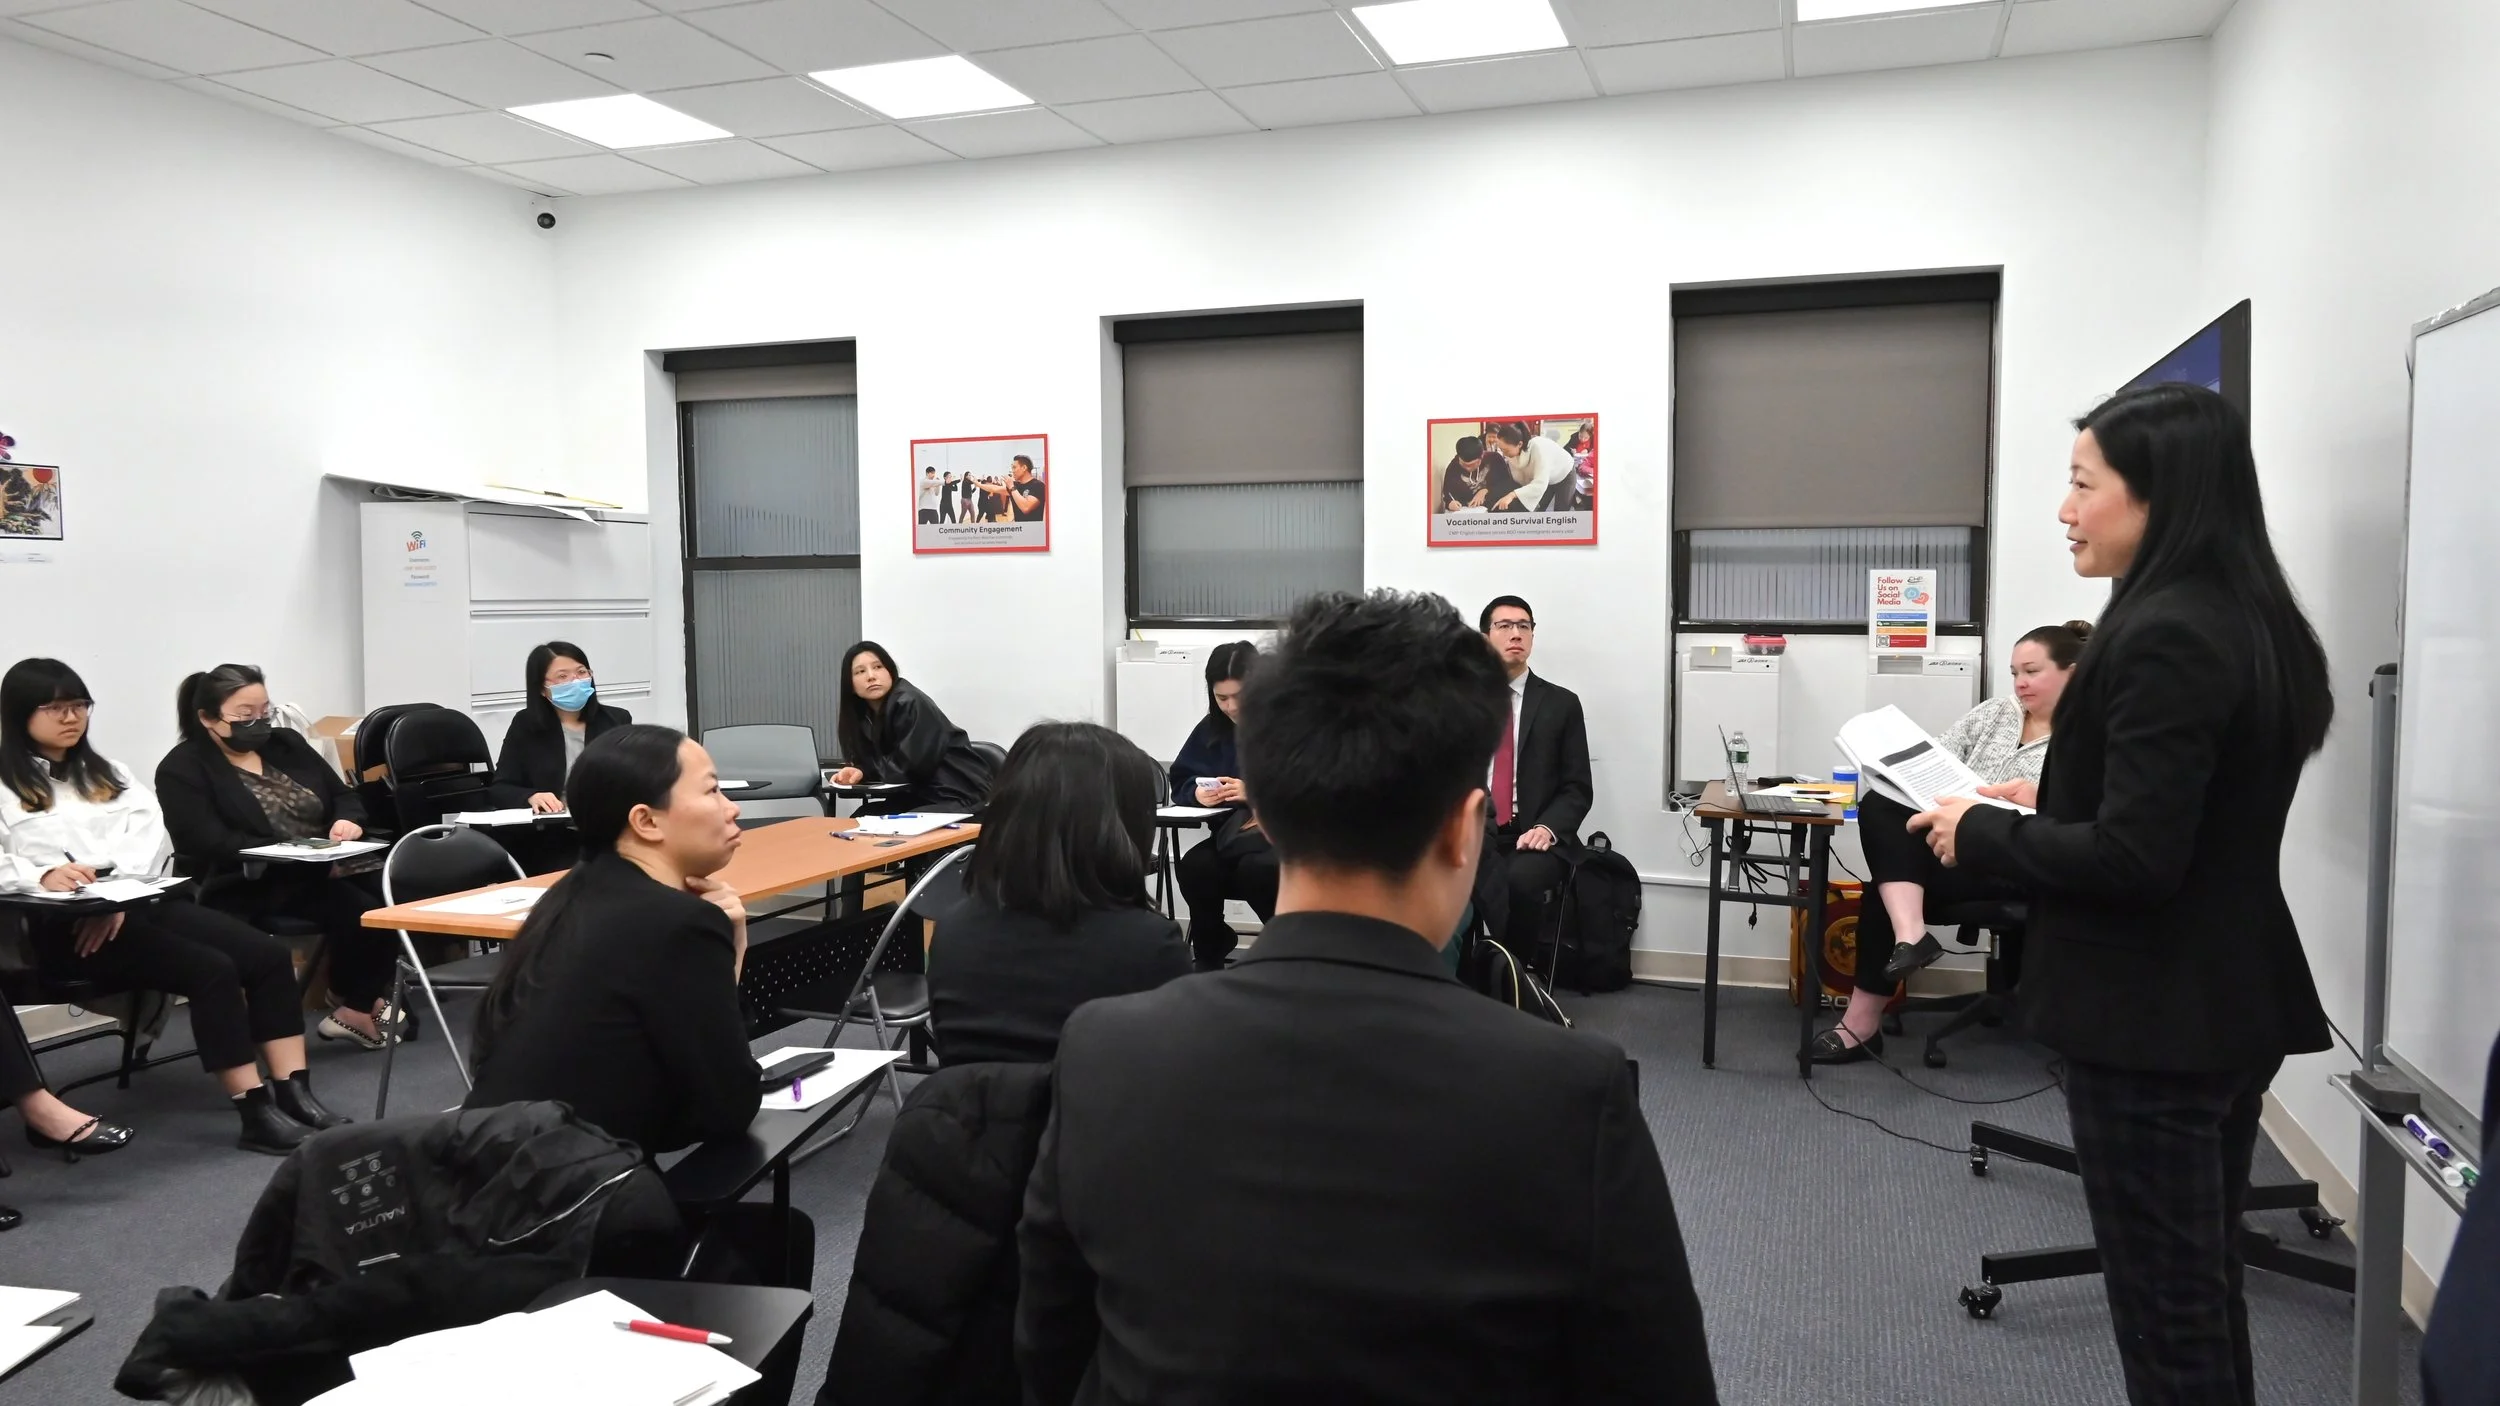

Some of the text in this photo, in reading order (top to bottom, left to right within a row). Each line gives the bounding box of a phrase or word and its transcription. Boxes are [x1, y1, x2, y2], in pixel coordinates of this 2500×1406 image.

[1446, 518, 1490, 526] Vocational
[1546, 517, 1577, 525] English
[979, 526, 1022, 534] Engagement
[1877, 576, 1903, 584] Follow
[1877, 598, 1901, 606] Media
[345, 1206, 405, 1235] NAUTICA
